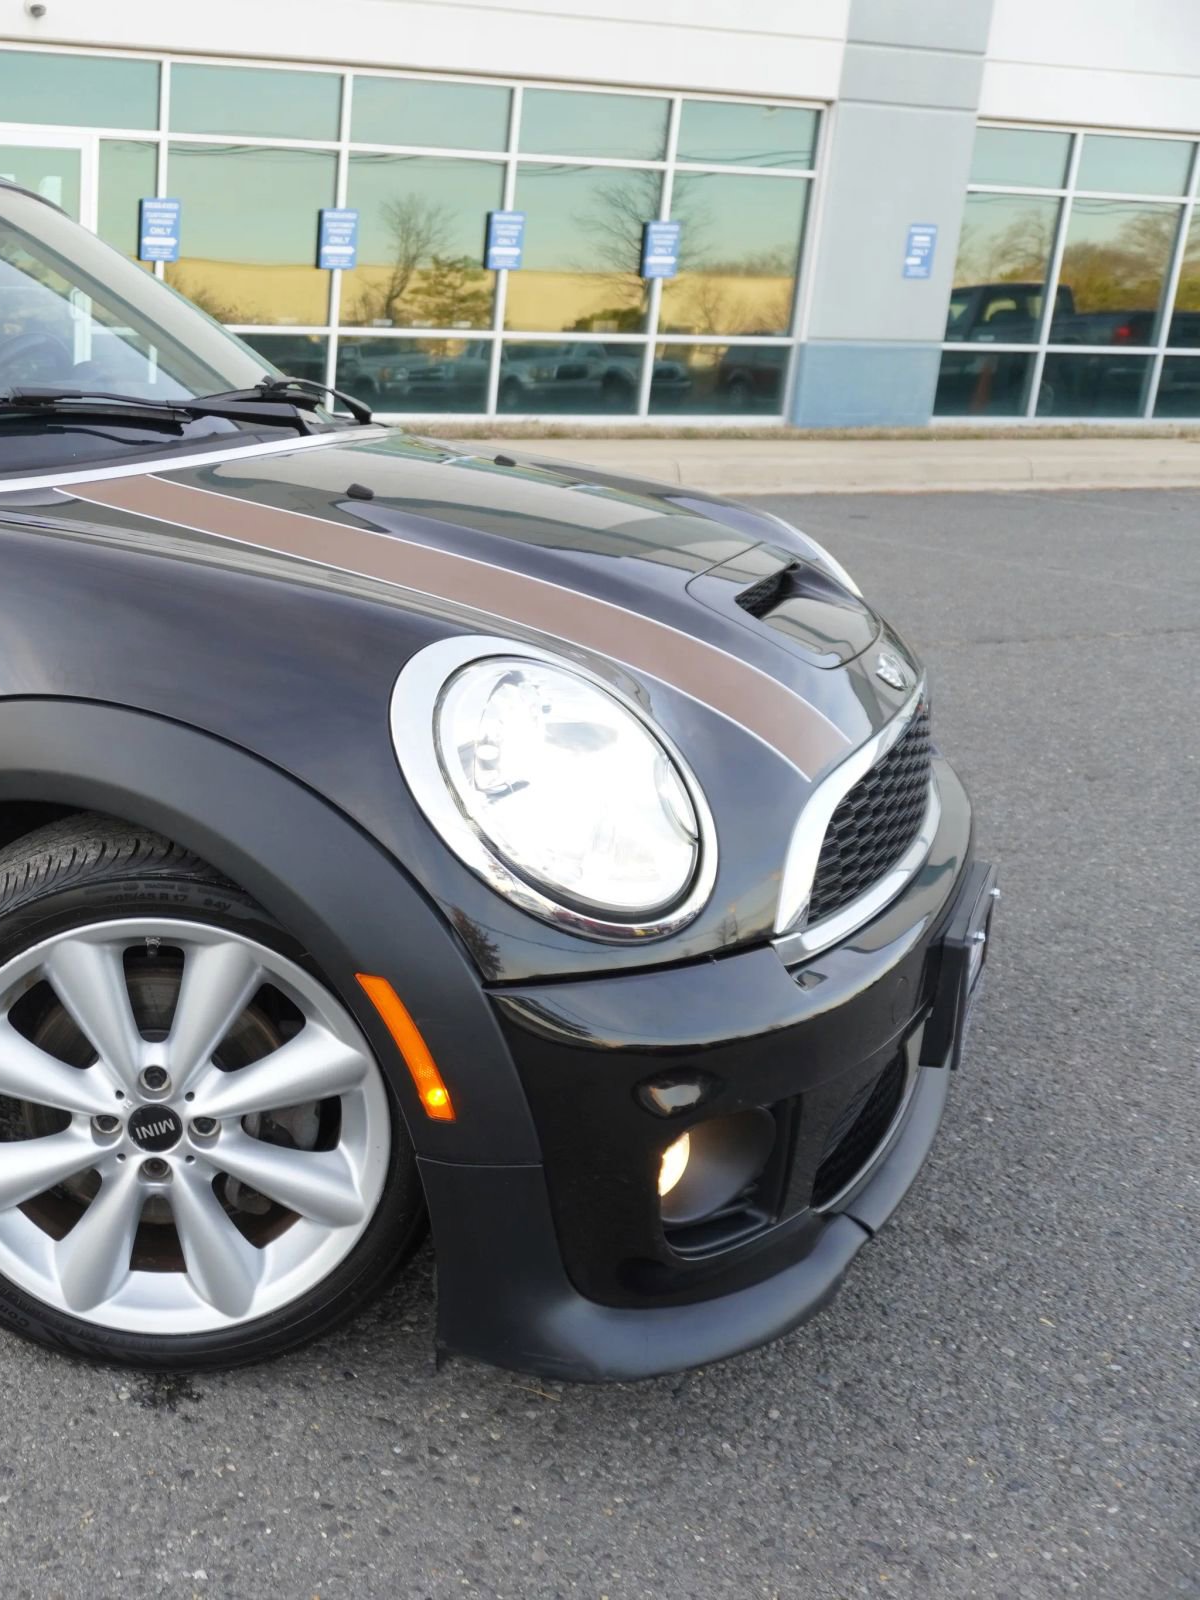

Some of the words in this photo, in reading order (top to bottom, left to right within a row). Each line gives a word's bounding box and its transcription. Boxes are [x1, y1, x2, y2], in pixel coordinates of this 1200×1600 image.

[150, 226, 172, 235] ONLY
[329, 236, 350, 244] ONLY
[135, 1118, 176, 1140] MINI
